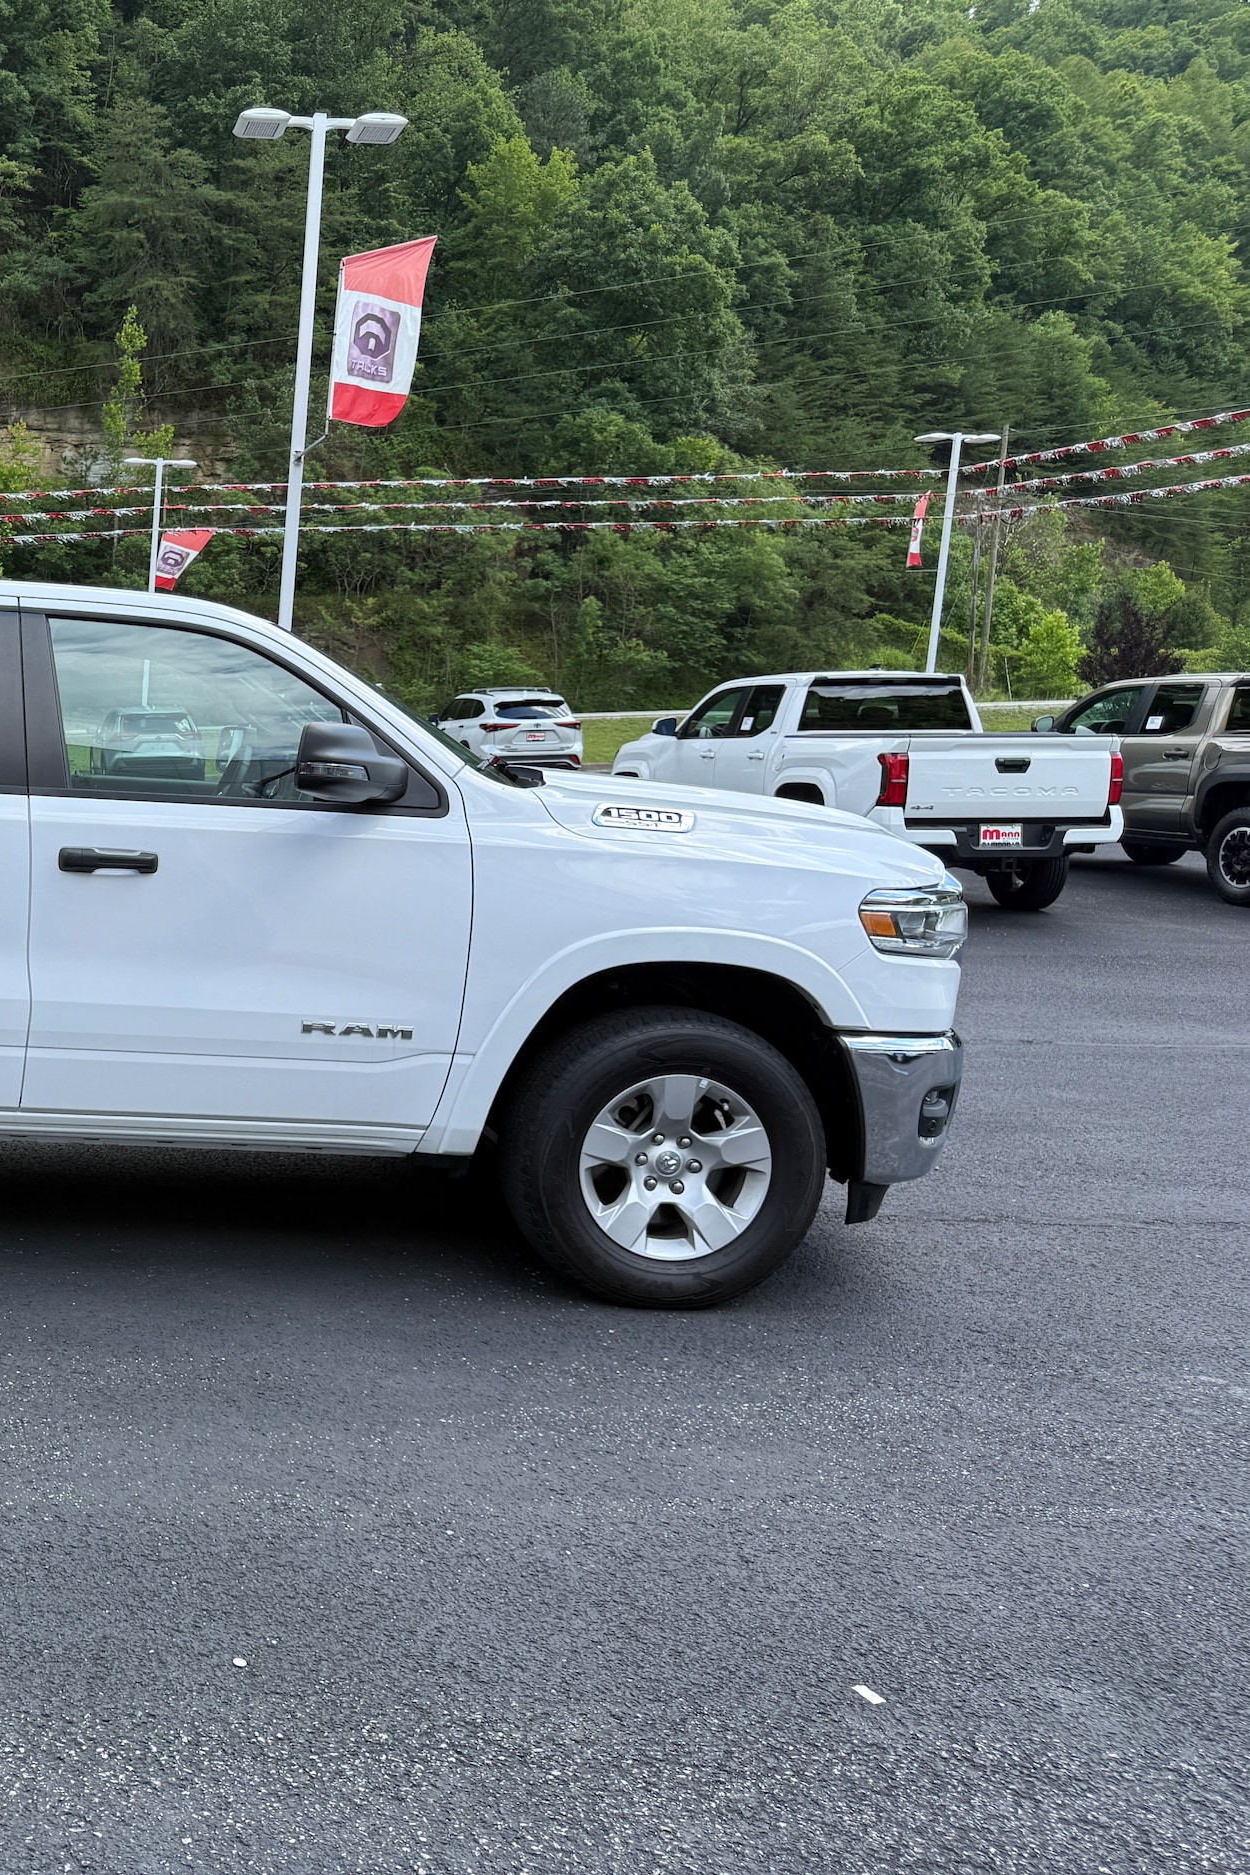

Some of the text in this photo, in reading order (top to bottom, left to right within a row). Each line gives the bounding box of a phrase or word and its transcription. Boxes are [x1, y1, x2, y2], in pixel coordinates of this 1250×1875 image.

[942, 787, 1078, 797] TACOMA
[606, 807, 681, 823] 1500
[301, 1020, 414, 1040] RAM
